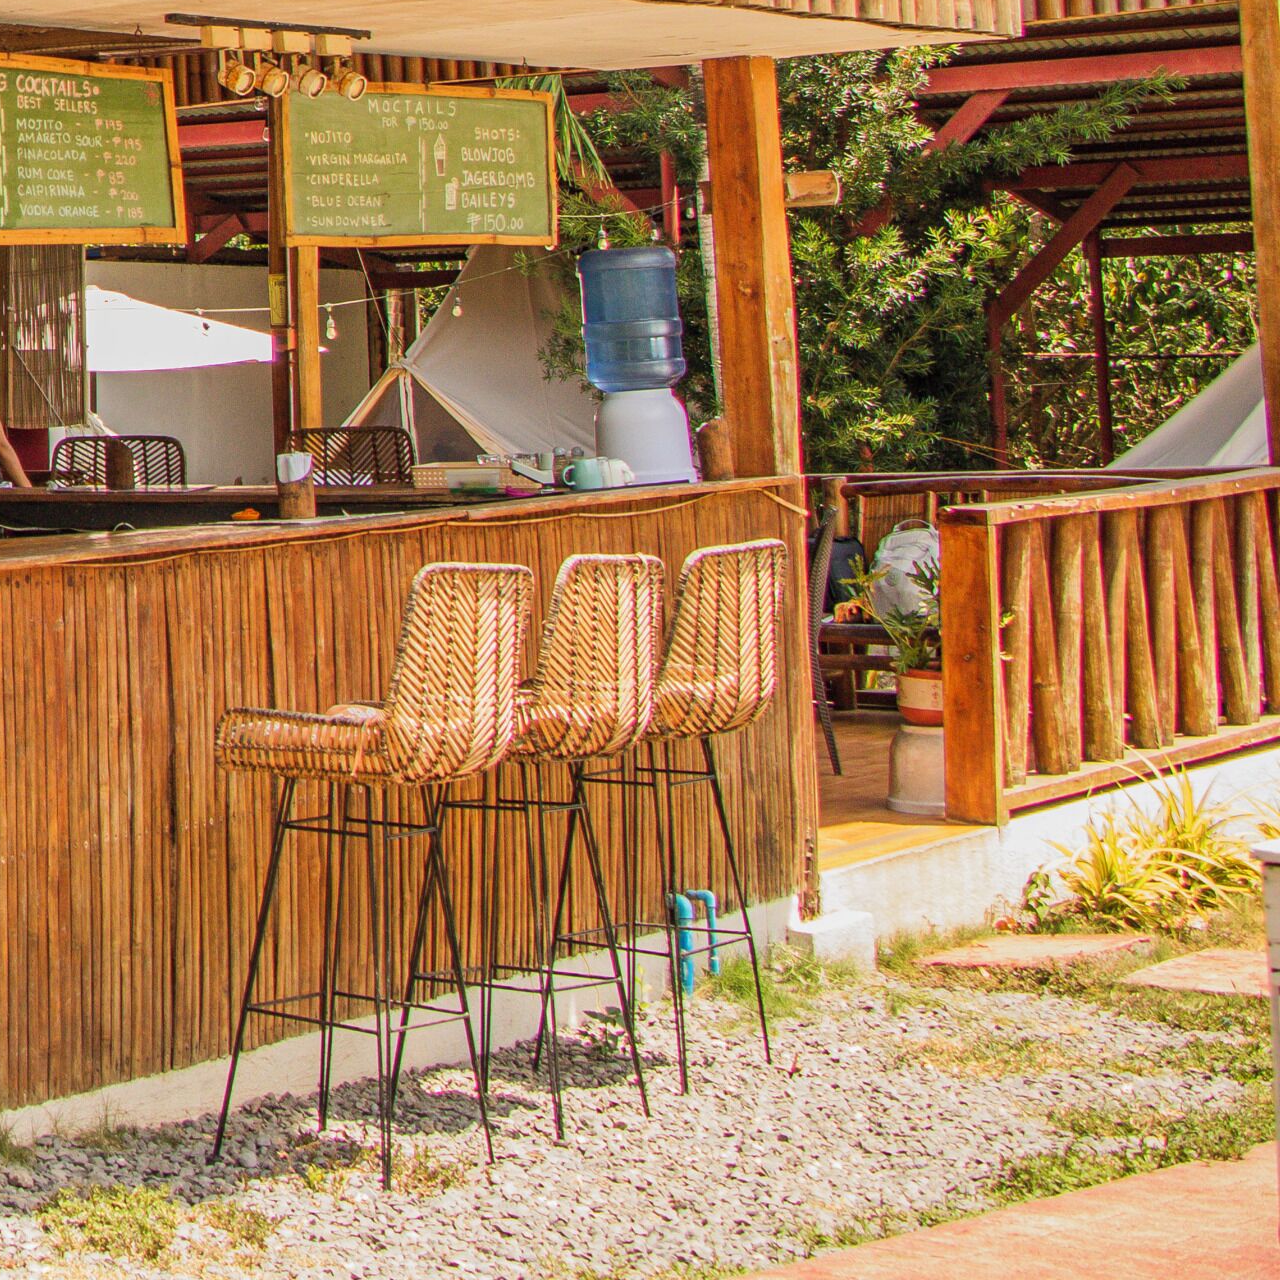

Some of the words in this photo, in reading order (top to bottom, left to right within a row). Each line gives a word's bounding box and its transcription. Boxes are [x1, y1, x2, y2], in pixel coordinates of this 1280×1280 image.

[16, 73, 92, 98] COCKTAILS
[16, 95, 42, 109] BEST
[54, 98, 98, 115] SELLERS
[368, 99, 457, 117] MOCTAILS
[16, 118, 63, 131] MOJITO
[382, 116, 399, 128] FOR
[17, 131, 71, 145] AMARETO
[75, 135, 103, 148] SOUR
[310, 130, 352, 144] NOJITO
[474, 127, 521, 142] SHOTS:
[16, 148, 87, 162] PINACOLADA
[308, 153, 350, 166] VIRGIN
[353, 153, 409, 165] MARGARITA
[461, 146, 516, 164] BLOWJOB
[17, 166, 43, 180] RUM
[47, 168, 75, 181] COKE
[310, 173, 381, 187] CINDERELLA
[461, 170, 536, 189] JAGERBOMB
[17, 184, 85, 198] CAIPIRINHA
[311, 195, 342, 208] BLUE
[346, 195, 381, 208] OCEAN
[461, 191, 517, 209] BAILEYS
[19, 203, 55, 217] VODKA
[58, 206, 101, 218] ORANGE
[311, 214, 386, 228] SUNDOWNER
